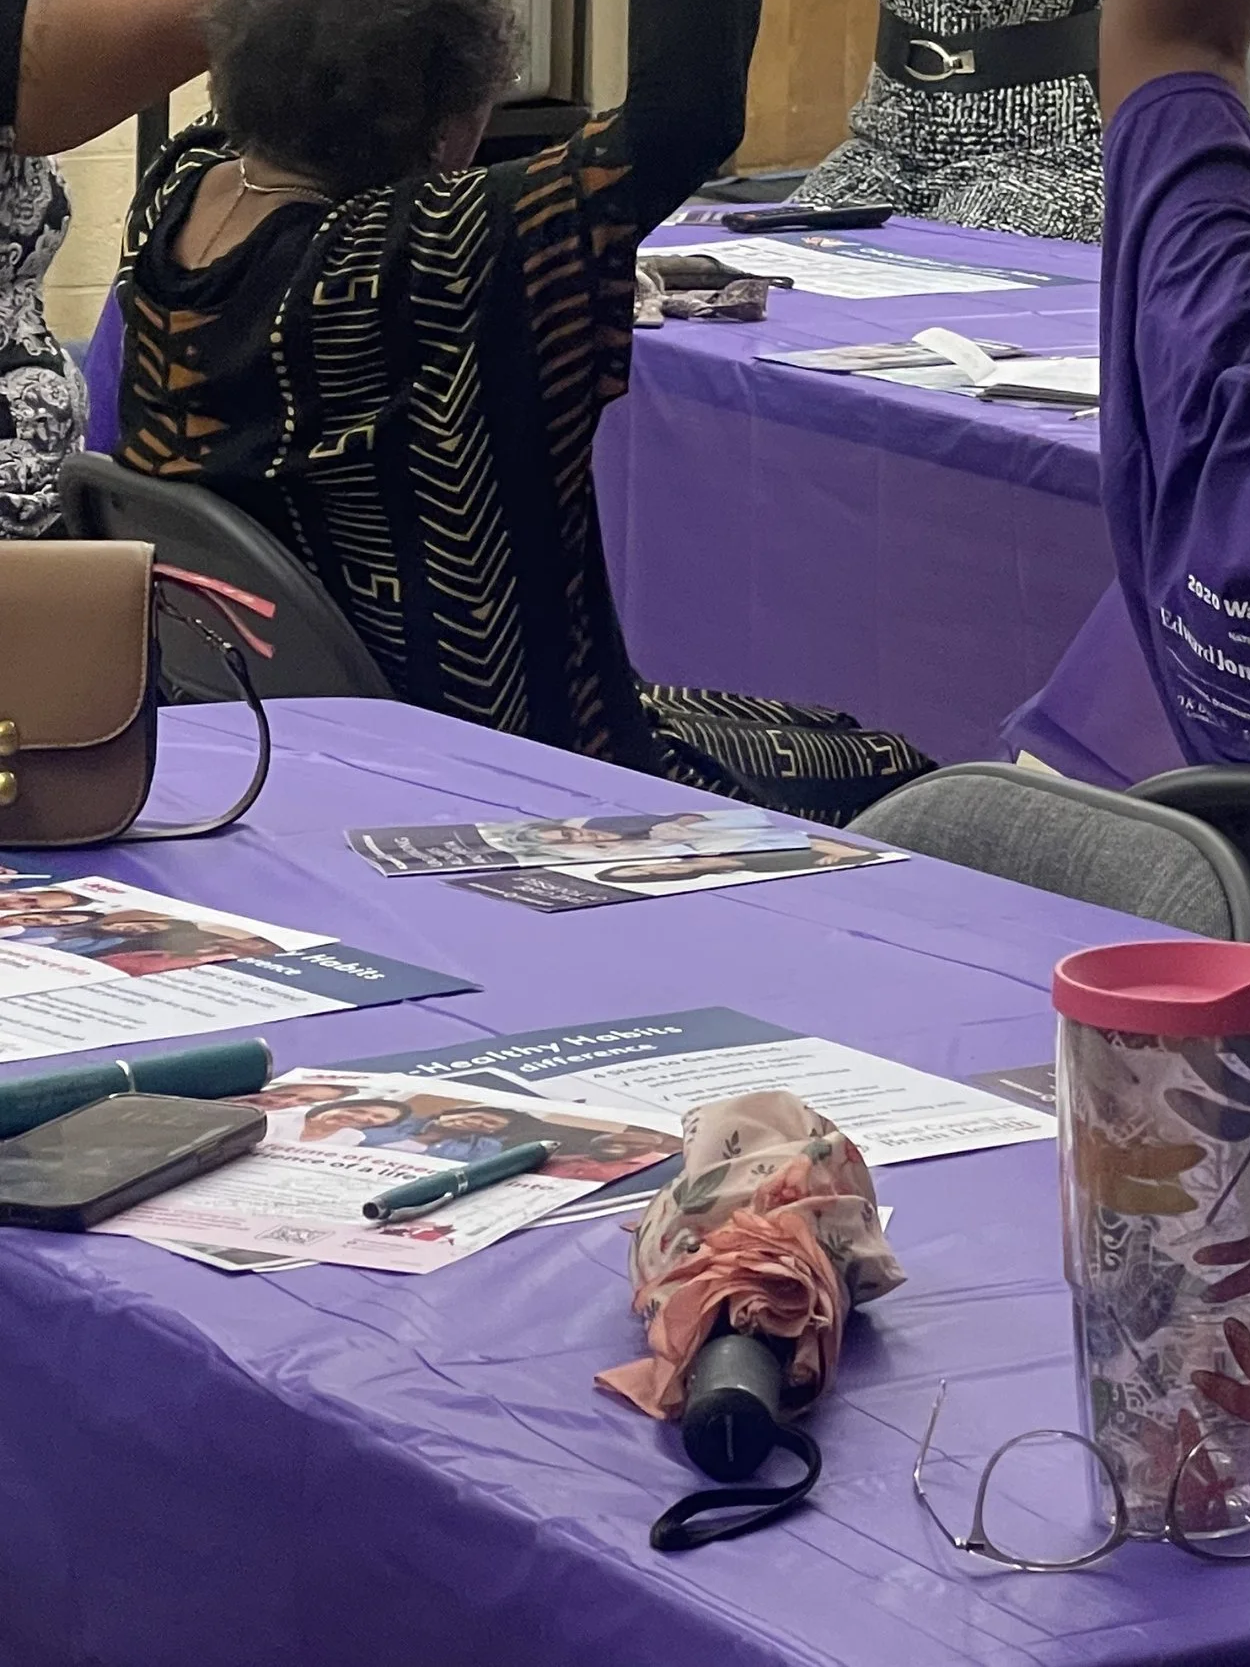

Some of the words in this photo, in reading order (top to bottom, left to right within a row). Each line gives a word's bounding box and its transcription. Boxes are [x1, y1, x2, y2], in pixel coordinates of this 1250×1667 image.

[1187, 574, 1221, 611] 2020
[1160, 606, 1215, 665] Edward
[300, 952, 385, 980] Habits
[562, 1024, 684, 1047] Habits
[518, 1043, 659, 1073] difference
[878, 1131, 950, 1148] Brain
[951, 1119, 1034, 1136] Health
[329, 1161, 359, 1170] of
